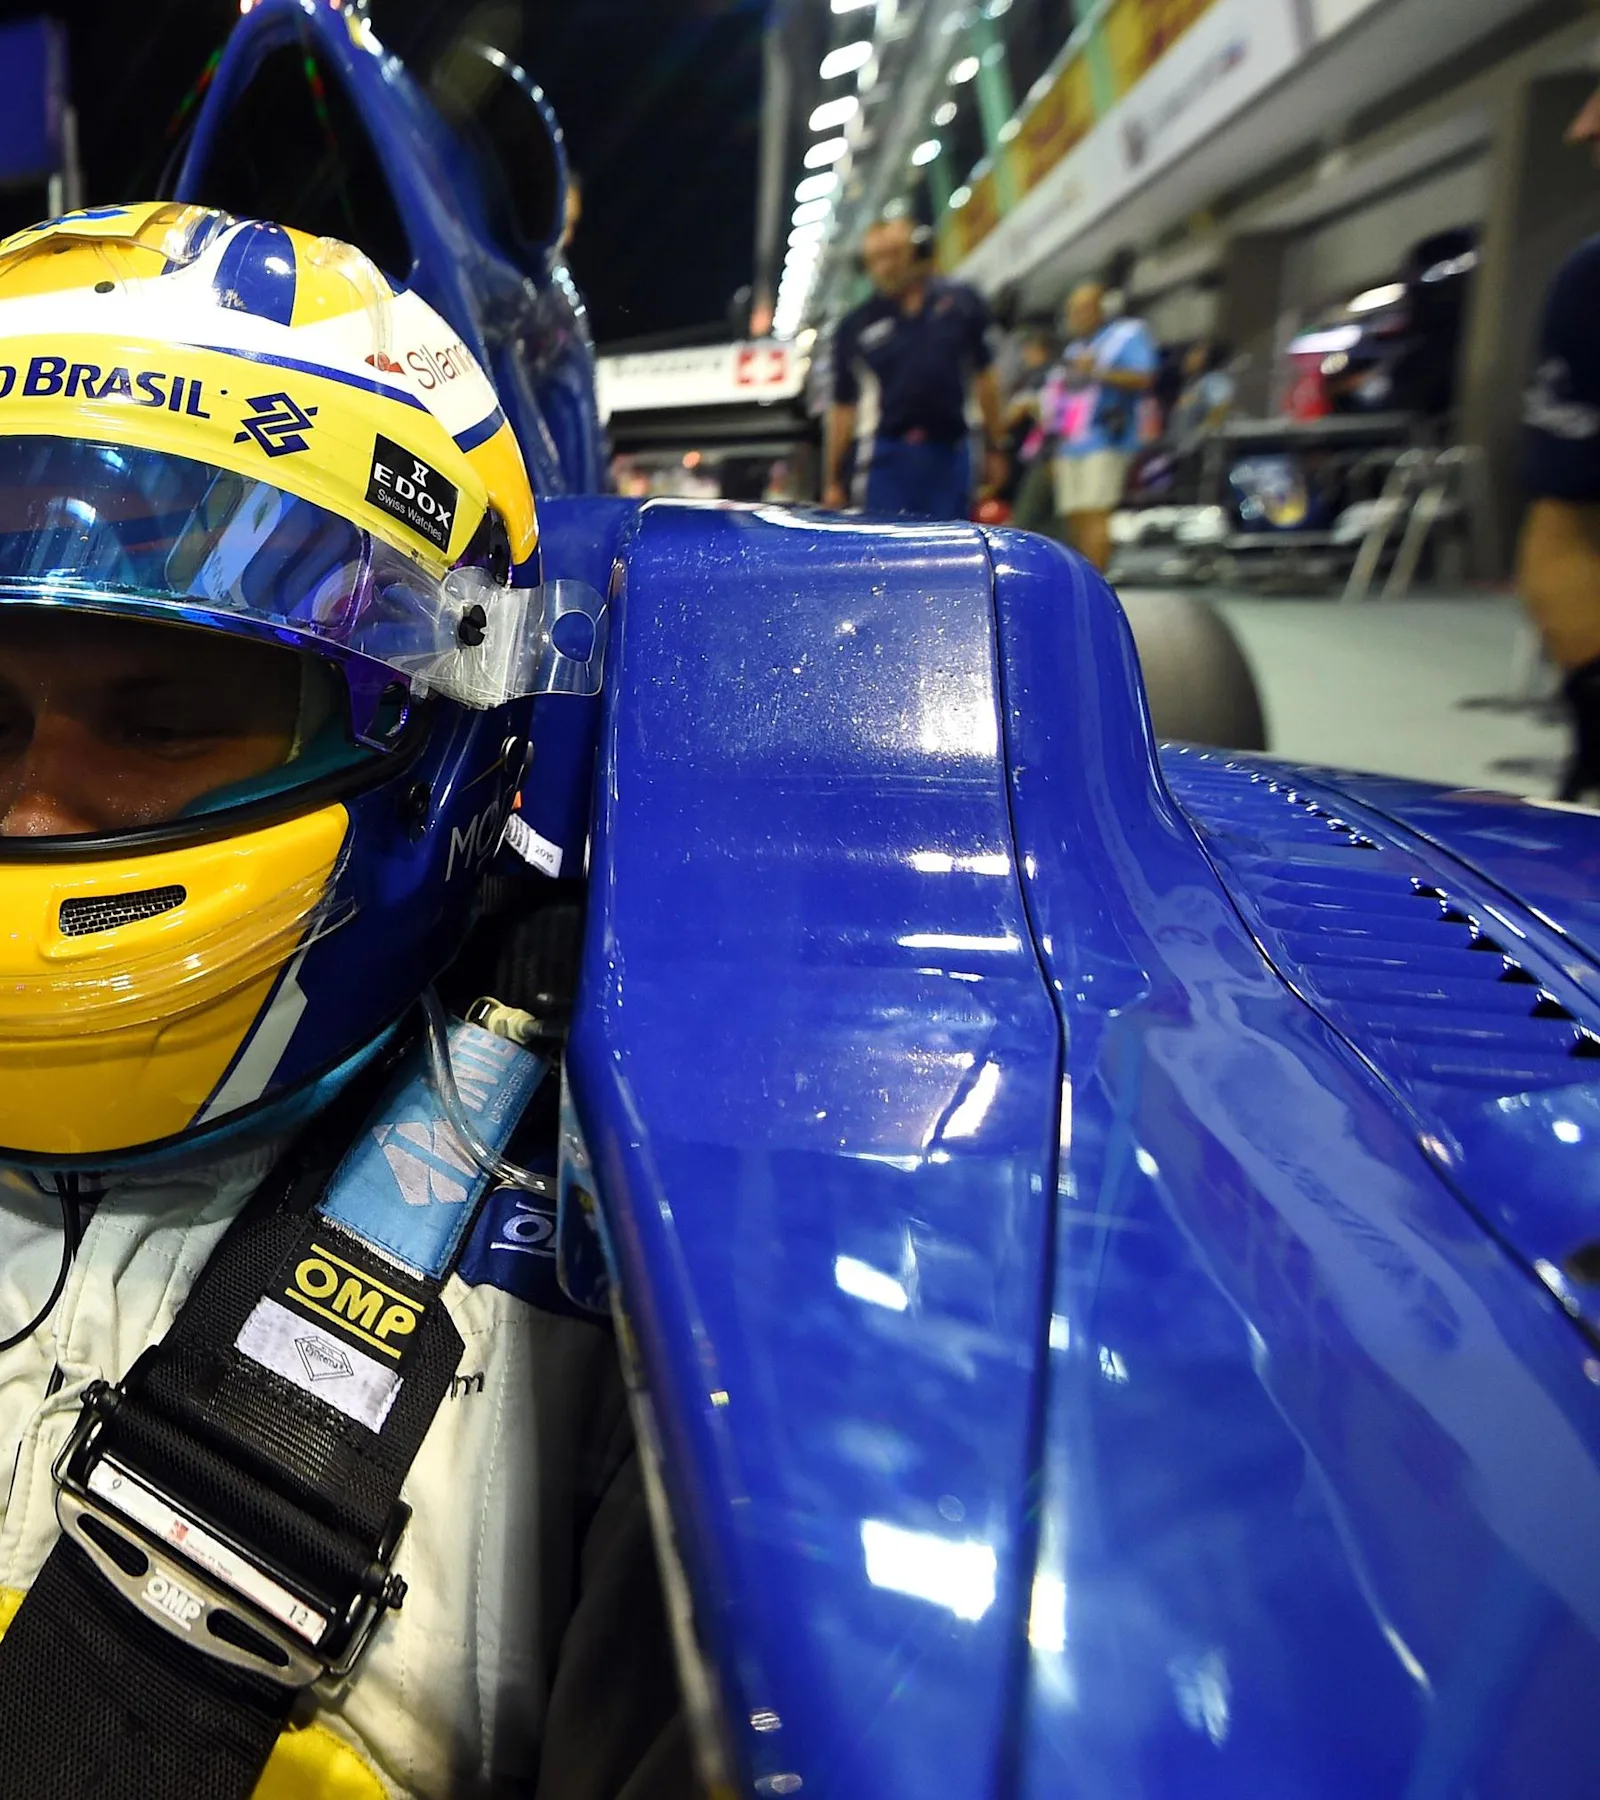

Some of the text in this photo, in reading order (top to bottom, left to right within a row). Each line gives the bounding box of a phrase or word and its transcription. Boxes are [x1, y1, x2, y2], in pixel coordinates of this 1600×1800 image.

[22, 357, 212, 419] BRASIL
[374, 462, 452, 529] EDOX
[377, 488, 442, 541] Swiss Watches
[295, 1258, 416, 1339] OMP
[147, 1577, 201, 1621] OMP
[288, 1604, 309, 1626] 12
